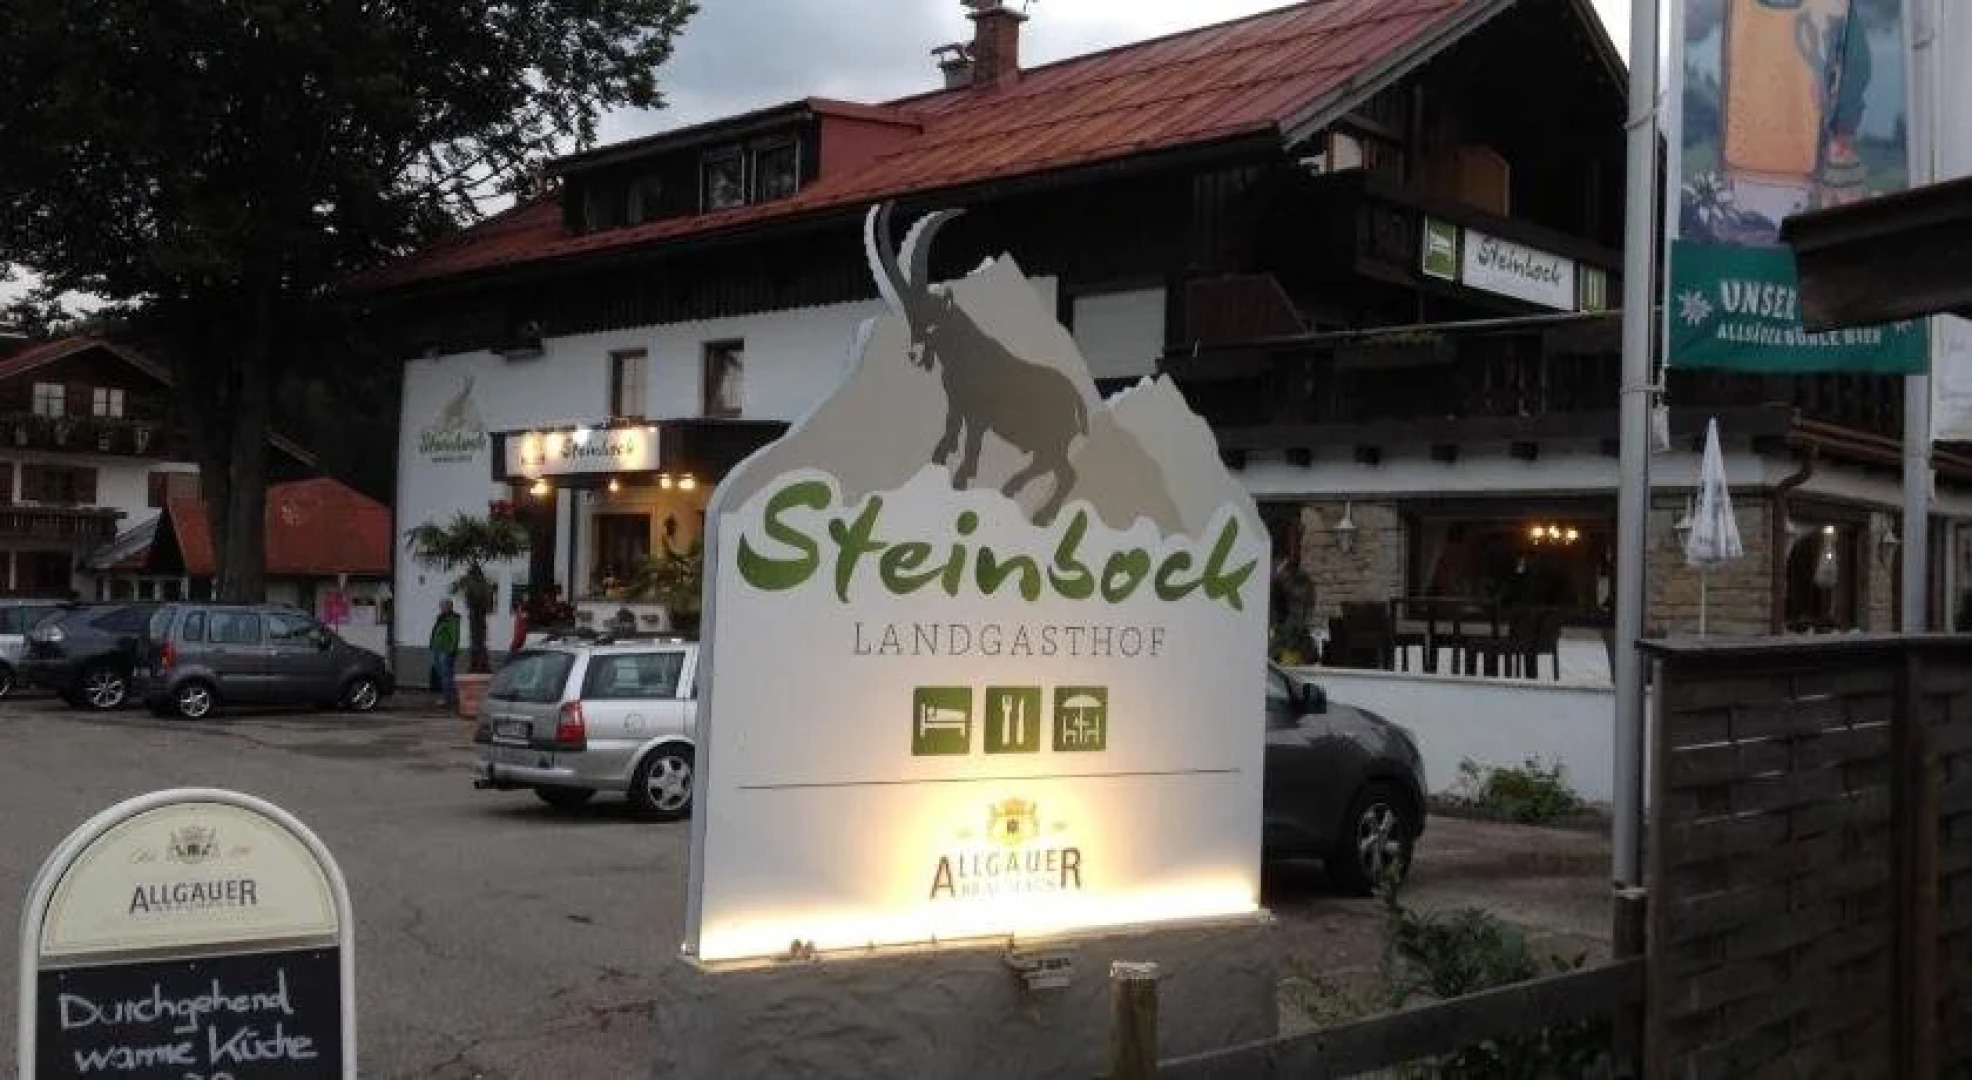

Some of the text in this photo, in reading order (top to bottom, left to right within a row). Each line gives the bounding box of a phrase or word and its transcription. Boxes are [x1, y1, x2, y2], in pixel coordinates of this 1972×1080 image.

[1478, 235, 1562, 286] Steinbock
[736, 480, 1258, 611] Steinbock
[853, 622, 1167, 657] LANDGASTHOF
[58, 966, 295, 1034] Durchgehend
